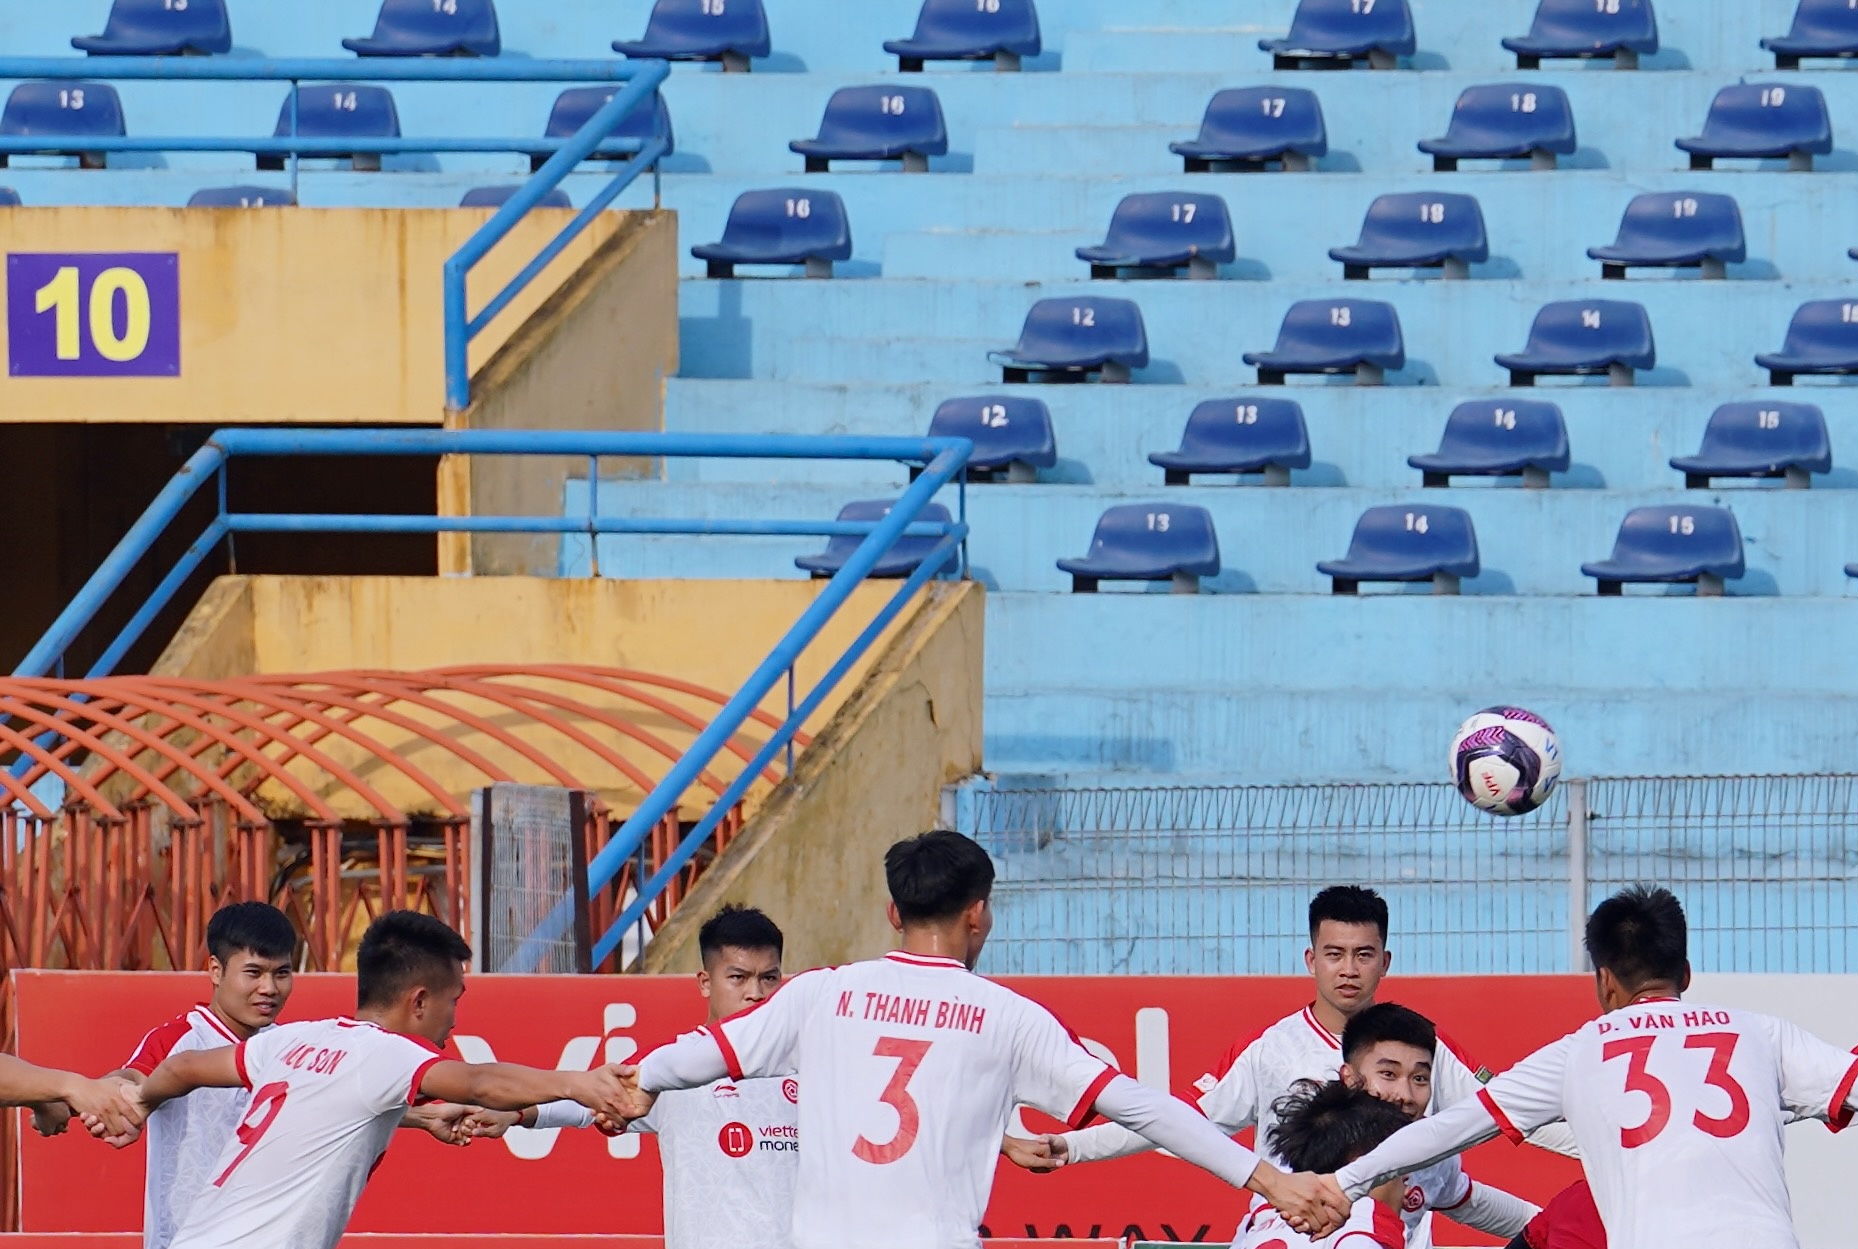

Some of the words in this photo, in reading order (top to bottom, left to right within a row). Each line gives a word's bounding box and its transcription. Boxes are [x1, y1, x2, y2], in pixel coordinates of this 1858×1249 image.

[59, 89, 84, 109] 13
[333, 91, 357, 111] 14
[881, 95, 905, 114] 16
[1511, 93, 1536, 112] 18
[1761, 87, 1785, 106] 19
[1262, 98, 1286, 118] 17
[786, 198, 810, 218] 16
[1172, 203, 1196, 223] 17
[1420, 203, 1445, 223] 18
[1673, 198, 1698, 217] 19
[36, 267, 150, 361] 10
[1072, 307, 1095, 326] 12
[1330, 307, 1351, 326] 13
[1581, 309, 1600, 328] 14
[981, 404, 1007, 427] 12
[1236, 405, 1258, 424] 13
[1494, 408, 1516, 430] 14
[1147, 513, 1170, 531] 13
[1405, 512, 1429, 534] 14
[1669, 515, 1695, 535] 15
[836, 991, 854, 1018] N.
[863, 992, 931, 1027] THANH
[934, 995, 986, 1034] BÌNH
[851, 1036, 934, 1165] 3
[1602, 1032, 1750, 1149] 33
[212, 1081, 290, 1188] 9
[759, 1124, 798, 1139] viette
[760, 1140, 799, 1152] mone
